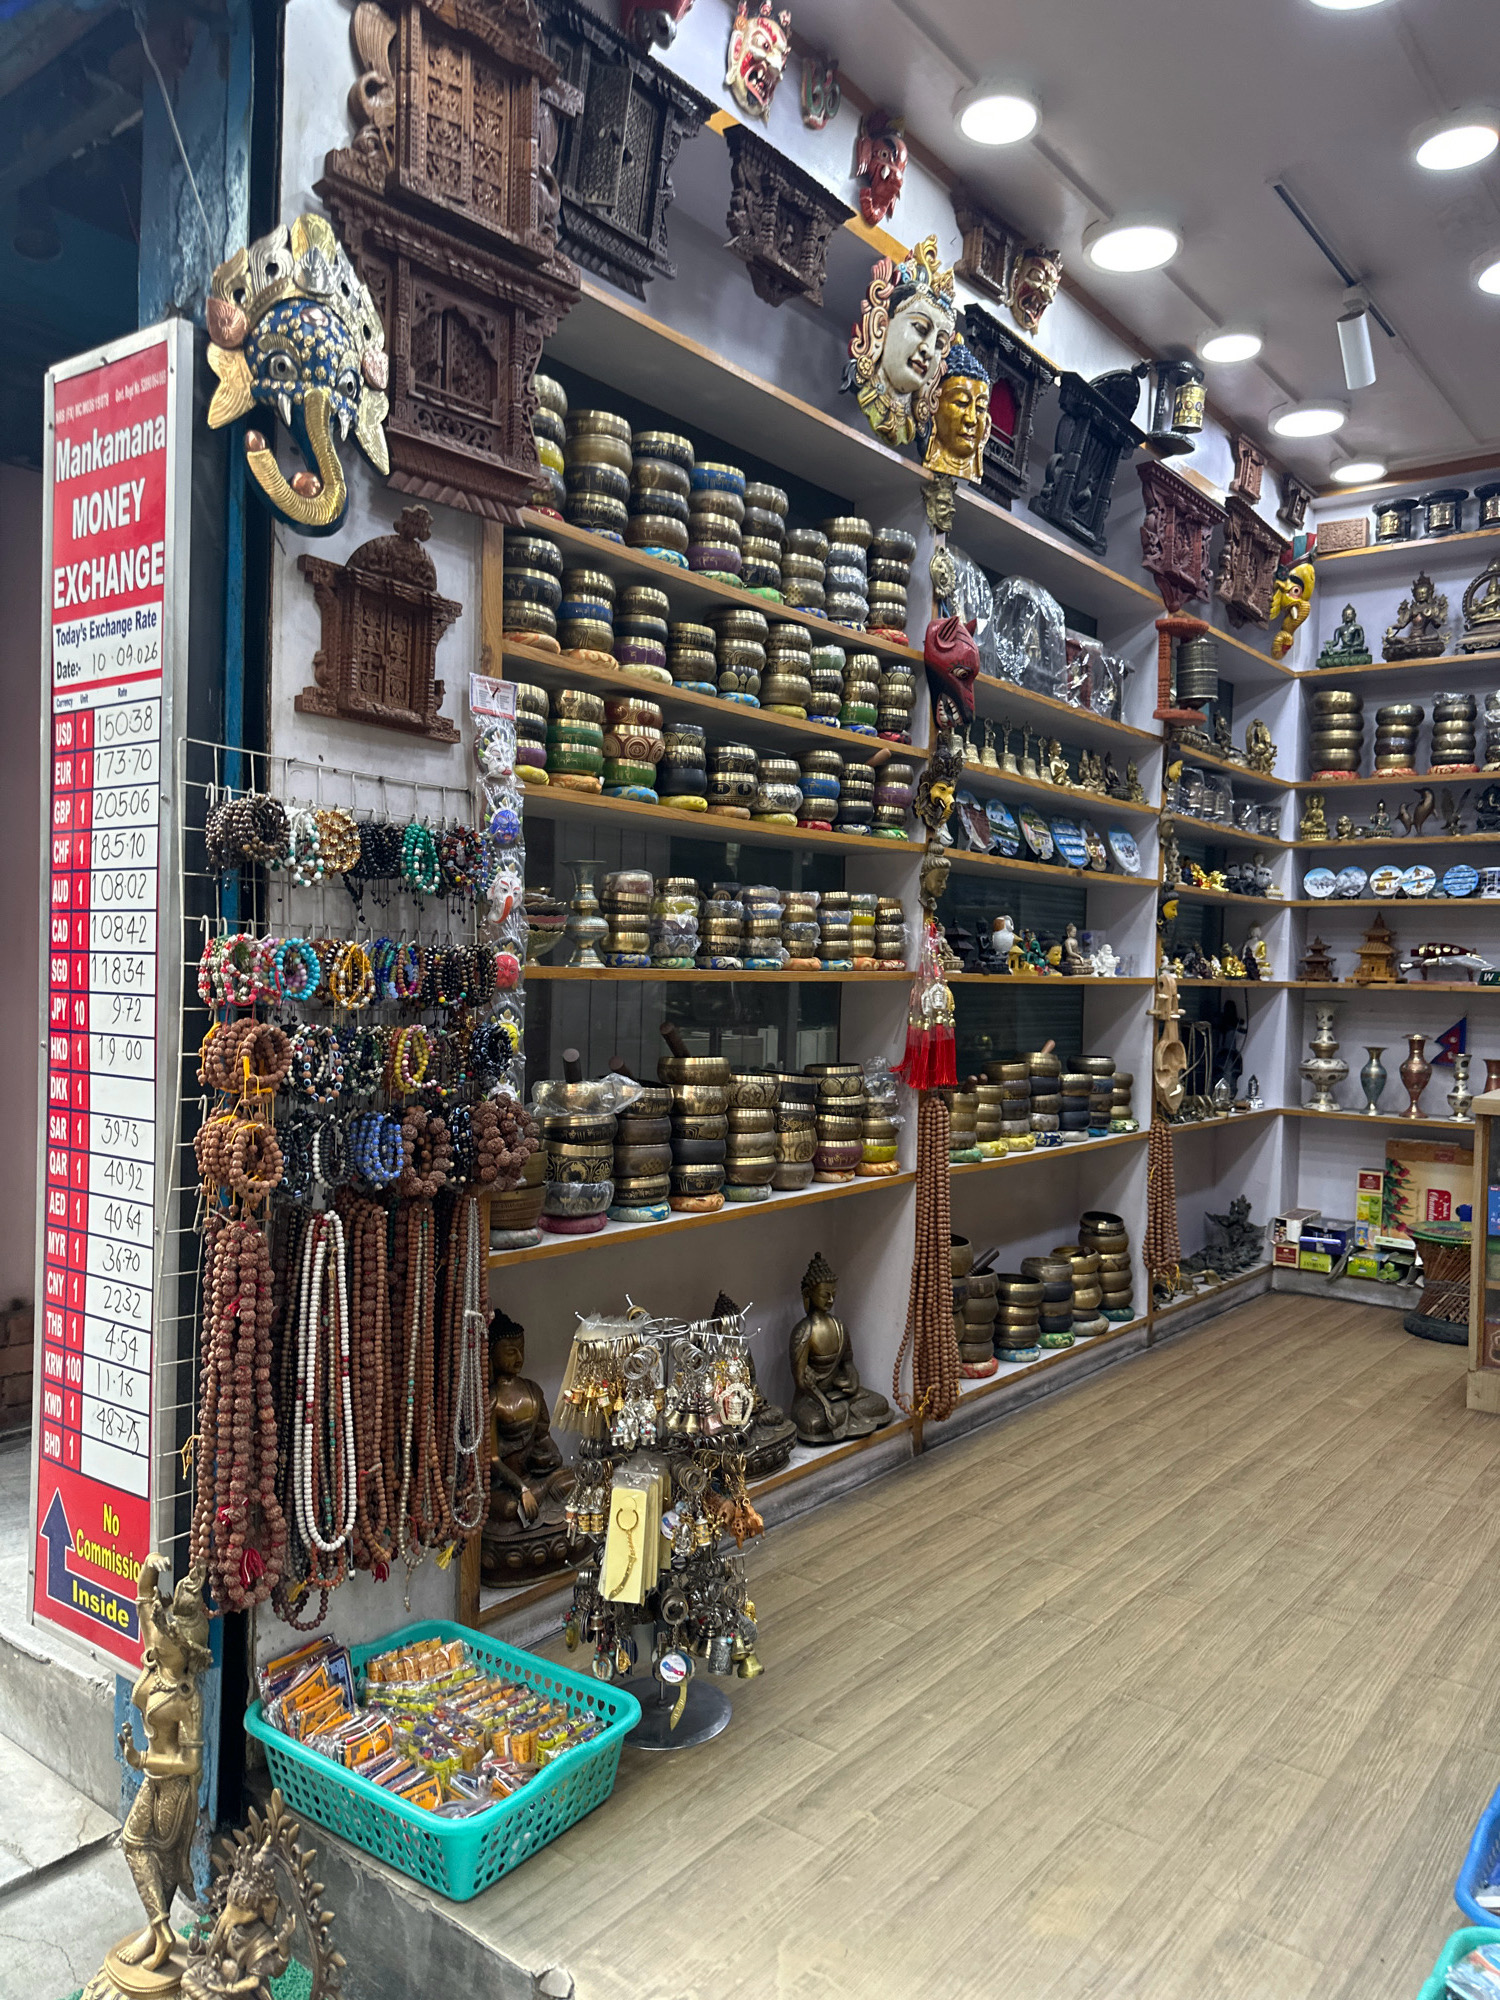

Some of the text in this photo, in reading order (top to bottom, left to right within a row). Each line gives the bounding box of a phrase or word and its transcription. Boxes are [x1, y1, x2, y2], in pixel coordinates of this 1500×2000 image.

[56, 414, 166, 483] Mankamana
[72, 477, 146, 540] MONEY
[54, 541, 164, 610] EXCHANGE
[56, 610, 156, 648] Today's Exchange Rate
[56, 688, 128, 708] Currency Unit Rate
[56, 722, 72, 746] USD
[82, 718, 87, 743] 1
[56, 761, 72, 785] EUR
[81, 758, 86, 784] 1
[54, 800, 70, 824] GBP
[80, 799, 85, 824] 1
[54, 840, 69, 864] CHF
[79, 840, 84, 864] 1
[52, 880, 68, 902] AUD
[78, 880, 83, 904] 1
[52, 920, 68, 942] CAD
[78, 920, 82, 944] 1
[52, 959, 68, 982] SGD
[77, 960, 82, 985] 1
[52, 998, 67, 1020] JPY
[75, 1000, 85, 1025] 10
[50, 1036, 68, 1060] HKD
[77, 1040, 82, 1064] 1
[50, 1077, 82, 1104] DKK 1
[50, 1116, 67, 1140] SAR
[77, 1119, 82, 1144] 1
[50, 1151, 67, 1176] QAR
[77, 1159, 81, 1184] 1
[50, 1191, 66, 1216] AED
[76, 1198, 80, 1224] 1
[48, 1231, 66, 1252] MYR
[75, 1238, 80, 1262] 1
[48, 1271, 64, 1297] CNY
[73, 1278, 78, 1302] 1
[47, 1312, 62, 1338] THB
[72, 1318, 76, 1342] 1
[45, 1351, 63, 1378] KRW
[66, 1356, 81, 1383] 100
[44, 1391, 62, 1418] KWD
[70, 1396, 75, 1421] 1
[44, 1430, 74, 1460] BHD 1
[103, 1503, 120, 1536] No
[76, 1528, 143, 1584] Commissio
[72, 1580, 129, 1628] Inside
